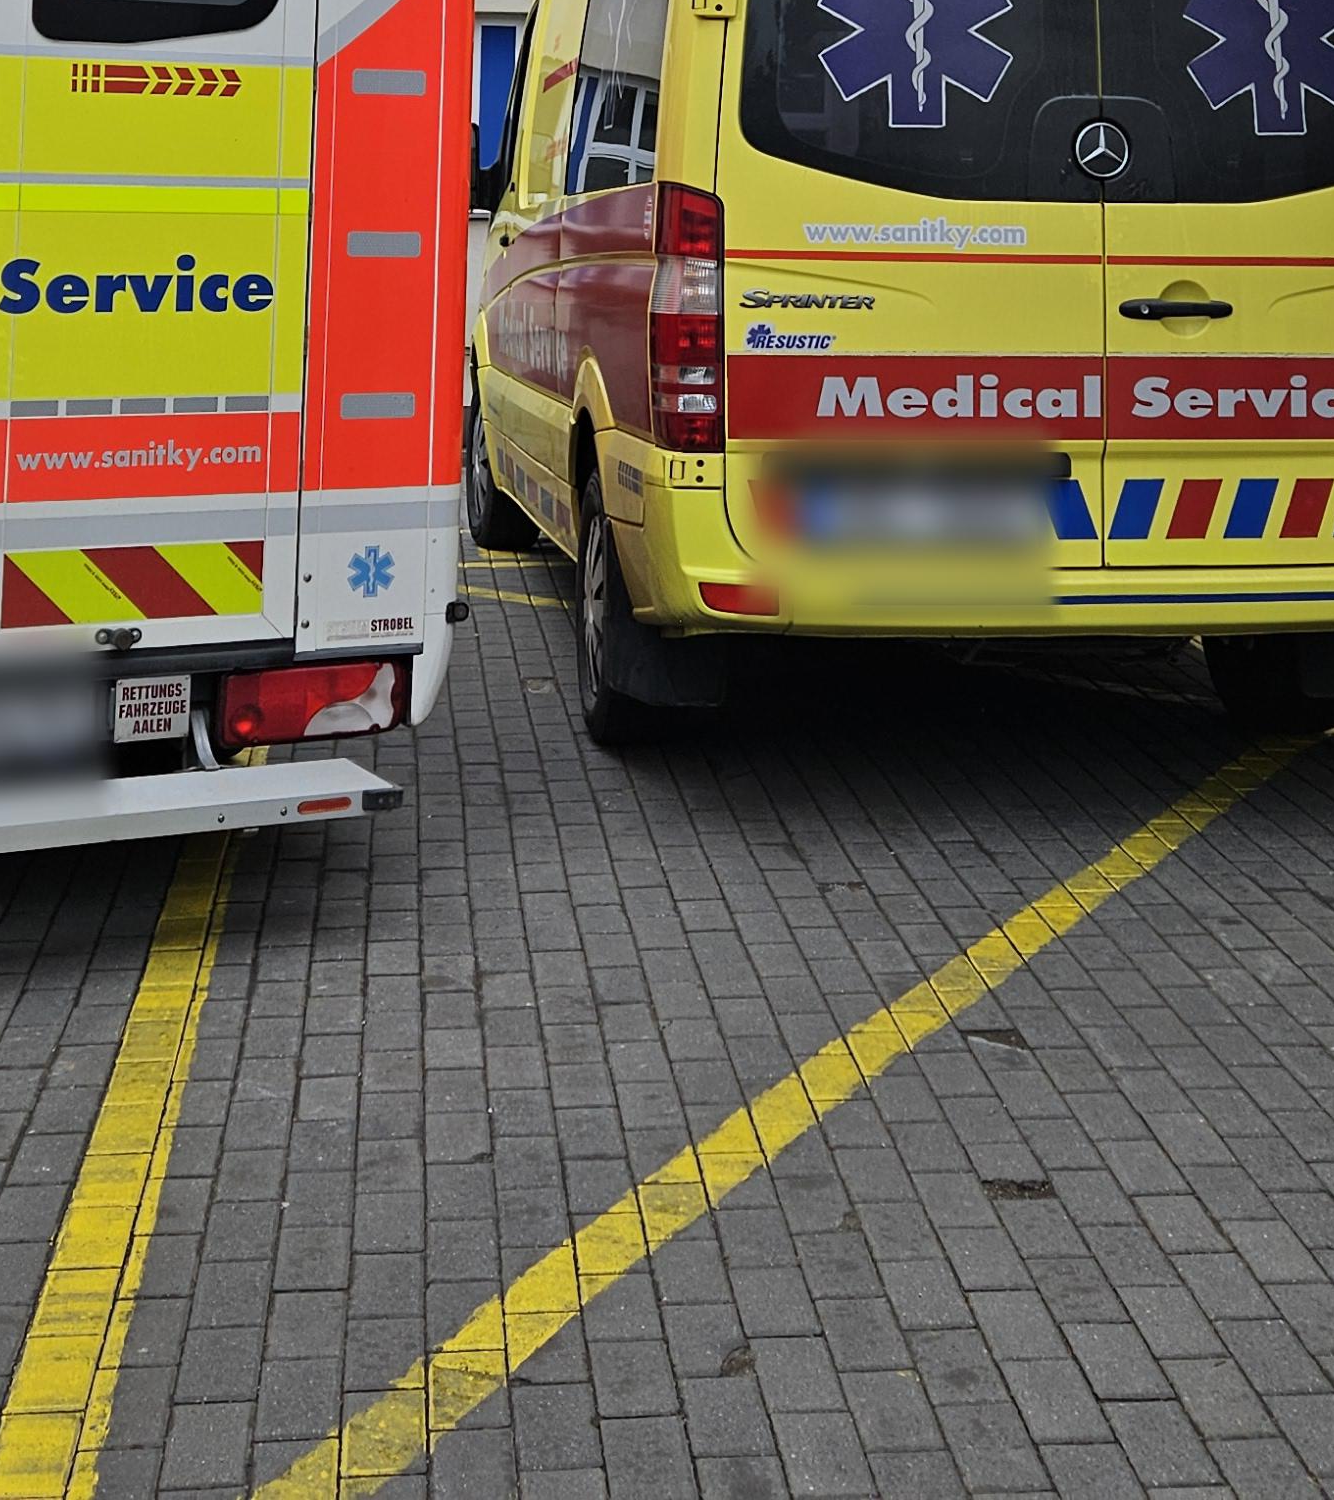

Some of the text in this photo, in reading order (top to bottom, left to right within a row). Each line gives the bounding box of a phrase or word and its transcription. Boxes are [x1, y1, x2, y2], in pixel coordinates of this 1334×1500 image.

[805, 219, 1027, 249] www.sanitky.com
[816, 374, 1102, 419] Medical
[17, 439, 262, 472] www.sanitky.com
[371, 617, 414, 632] STROBEL
[122, 683, 186, 701] RETTUNGS-
[119, 700, 186, 719] FAHRZEUGE
[133, 718, 171, 735] AALEN
